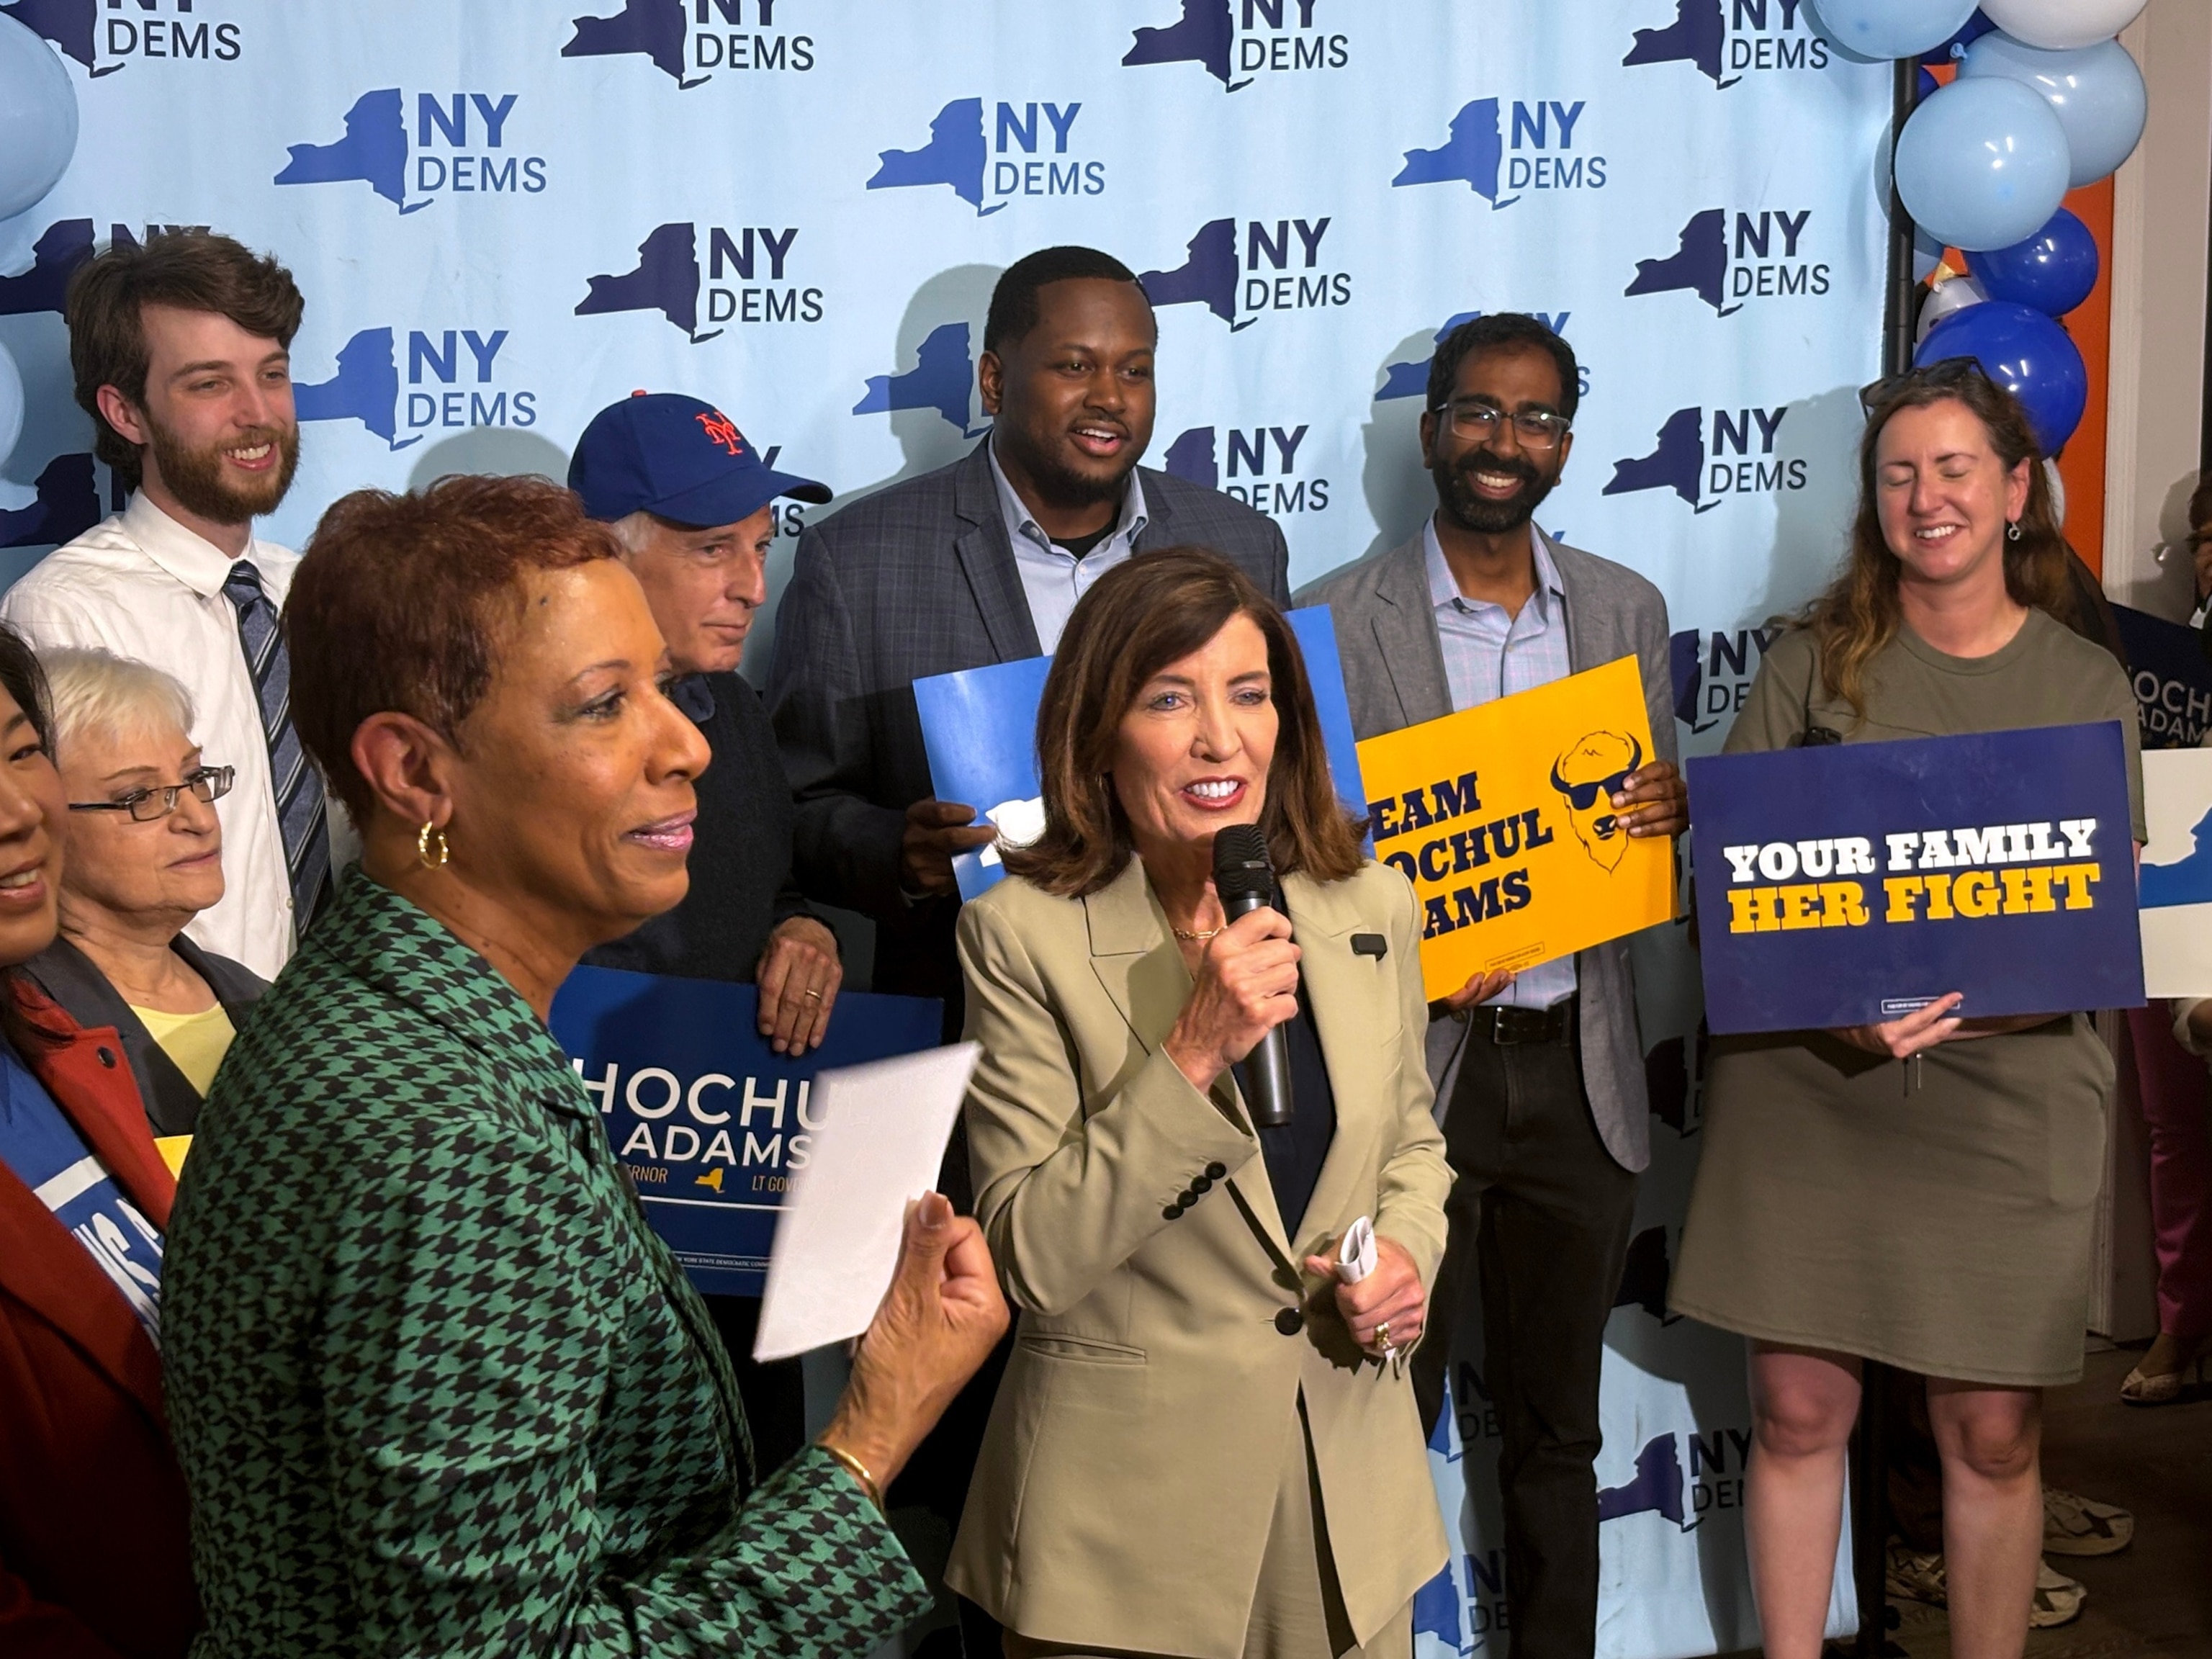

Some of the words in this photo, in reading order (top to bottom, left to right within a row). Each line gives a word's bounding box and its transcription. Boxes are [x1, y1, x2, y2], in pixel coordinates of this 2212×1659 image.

[108, 19, 240, 60] DEMS
[696, 33, 814, 71] DEMS
[1241, 35, 1348, 71] DEMS
[1732, 38, 1828, 69] DEMS
[418, 93, 518, 148] NY
[995, 102, 1082, 153] NY
[1511, 101, 1586, 149] NY
[418, 156, 547, 193] DEMS
[994, 162, 1105, 195] DEMS
[1509, 156, 1606, 189] DEMS
[709, 227, 799, 280] NY
[1247, 217, 1331, 270] NY
[1735, 210, 1811, 259] NY
[1245, 274, 1351, 310] DEMS
[1733, 264, 1829, 297] DEMS
[709, 288, 824, 323] DEMS
[408, 331, 509, 384] NY
[408, 392, 536, 427] DEMS
[1712, 407, 1786, 456] NY
[1227, 425, 1309, 477] NY
[1709, 459, 1807, 493] DEMS
[1707, 683, 1750, 714] DE
[2129, 666, 2211, 723] OCH
[1367, 770, 1481, 842] EAM
[1383, 807, 1553, 884] OCHUL
[1723, 837, 1875, 883] YOUR
[1885, 818, 2096, 871] FAMILY
[1423, 868, 1532, 940] AMS
[1727, 881, 1870, 933] HER
[1883, 863, 2101, 922] FIGHT
[572, 1058, 830, 1131] HOCHU
[621, 1121, 812, 1170] ADAMS
[629, 1164, 668, 1183] RNOR
[1691, 1479, 1743, 1512] DE
[1468, 1601, 1509, 1635] DE
